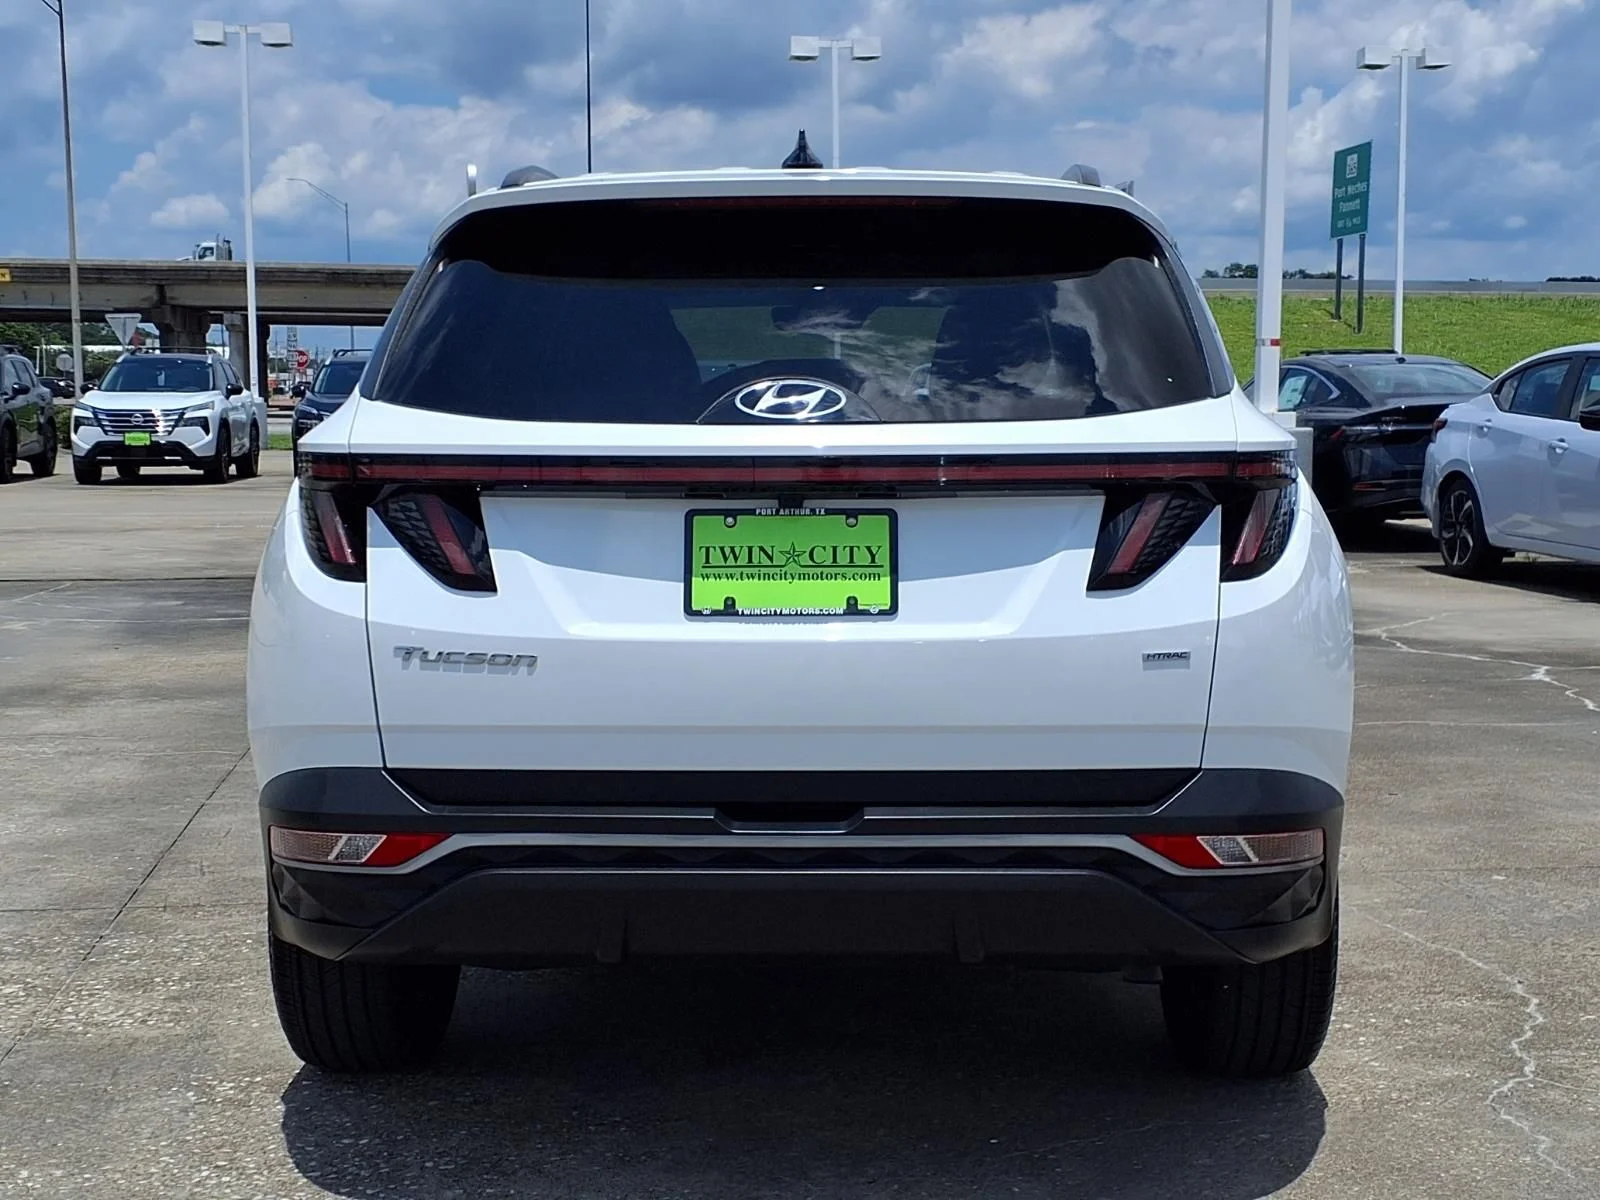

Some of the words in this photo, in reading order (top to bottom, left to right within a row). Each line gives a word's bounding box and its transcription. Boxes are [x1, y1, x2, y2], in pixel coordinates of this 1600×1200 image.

[756, 507, 777, 515] PORT
[815, 507, 826, 515] TX
[699, 545, 775, 565] TWIN
[808, 545, 883, 565] CITY
[700, 569, 881, 584] www.twincitymotors.com
[737, 607, 844, 615] TWINCITYMOTORS.COM
[1146, 651, 1188, 660] HTRAC
